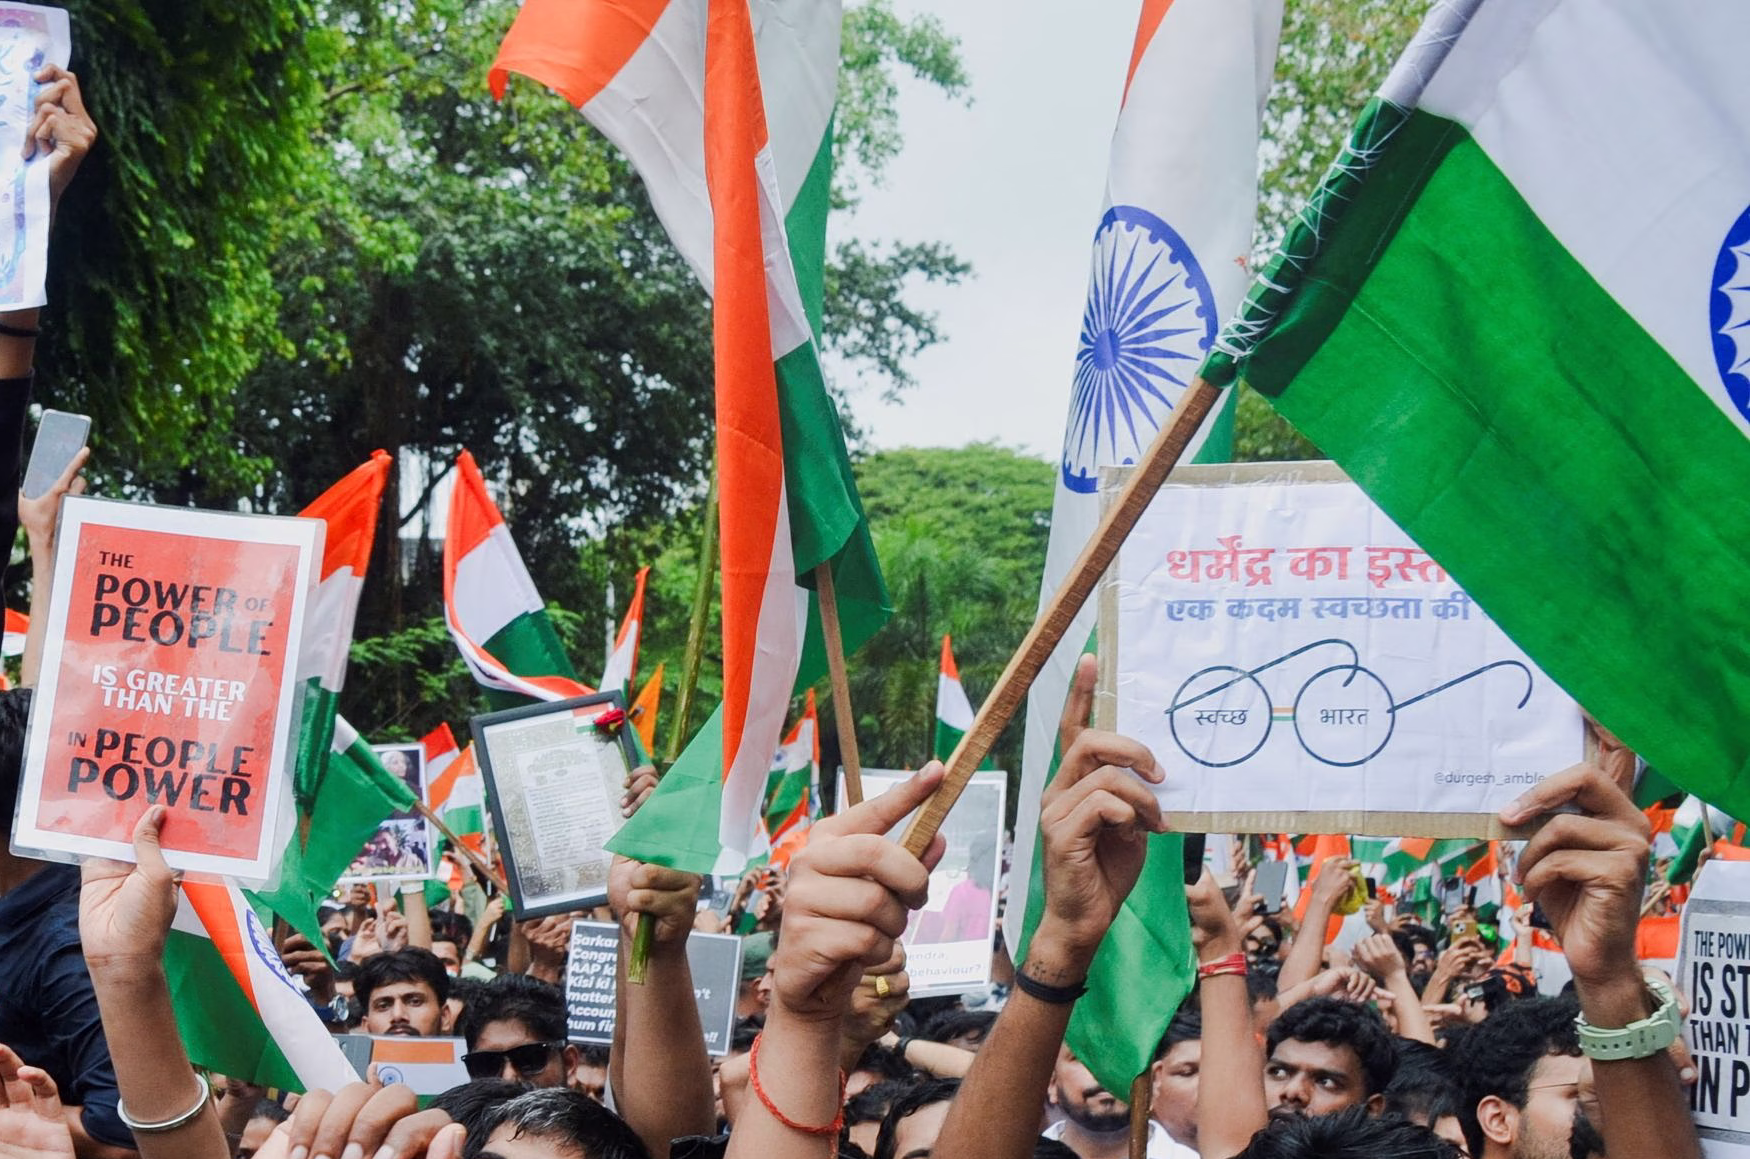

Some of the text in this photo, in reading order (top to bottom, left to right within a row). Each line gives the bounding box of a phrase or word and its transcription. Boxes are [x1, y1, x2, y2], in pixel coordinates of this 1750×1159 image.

[99, 550, 134, 569] THE
[1166, 535, 1275, 587] धर्मेंद्र
[1287, 547, 1350, 582] का
[94, 573, 270, 616] POWER OF
[1165, 590, 1471, 622] एक कदम स्वच्छता की
[90, 602, 273, 656] PEOPLE
[92, 664, 246, 701] IS GREATER
[101, 686, 233, 721] THAN THE
[1195, 708, 1249, 727] स्वच्छ
[1320, 708, 1369, 726] भारत
[68, 728, 254, 777] IN PEOPLE
[67, 757, 251, 816] POWER
[1694, 931, 1714, 958] THE
[570, 962, 601, 975] AAP
[595, 976, 610, 990] ki
[1692, 961, 1714, 1016] IS
[1690, 1020, 1739, 1056] THAN
[1690, 1055, 1721, 1114] IN
